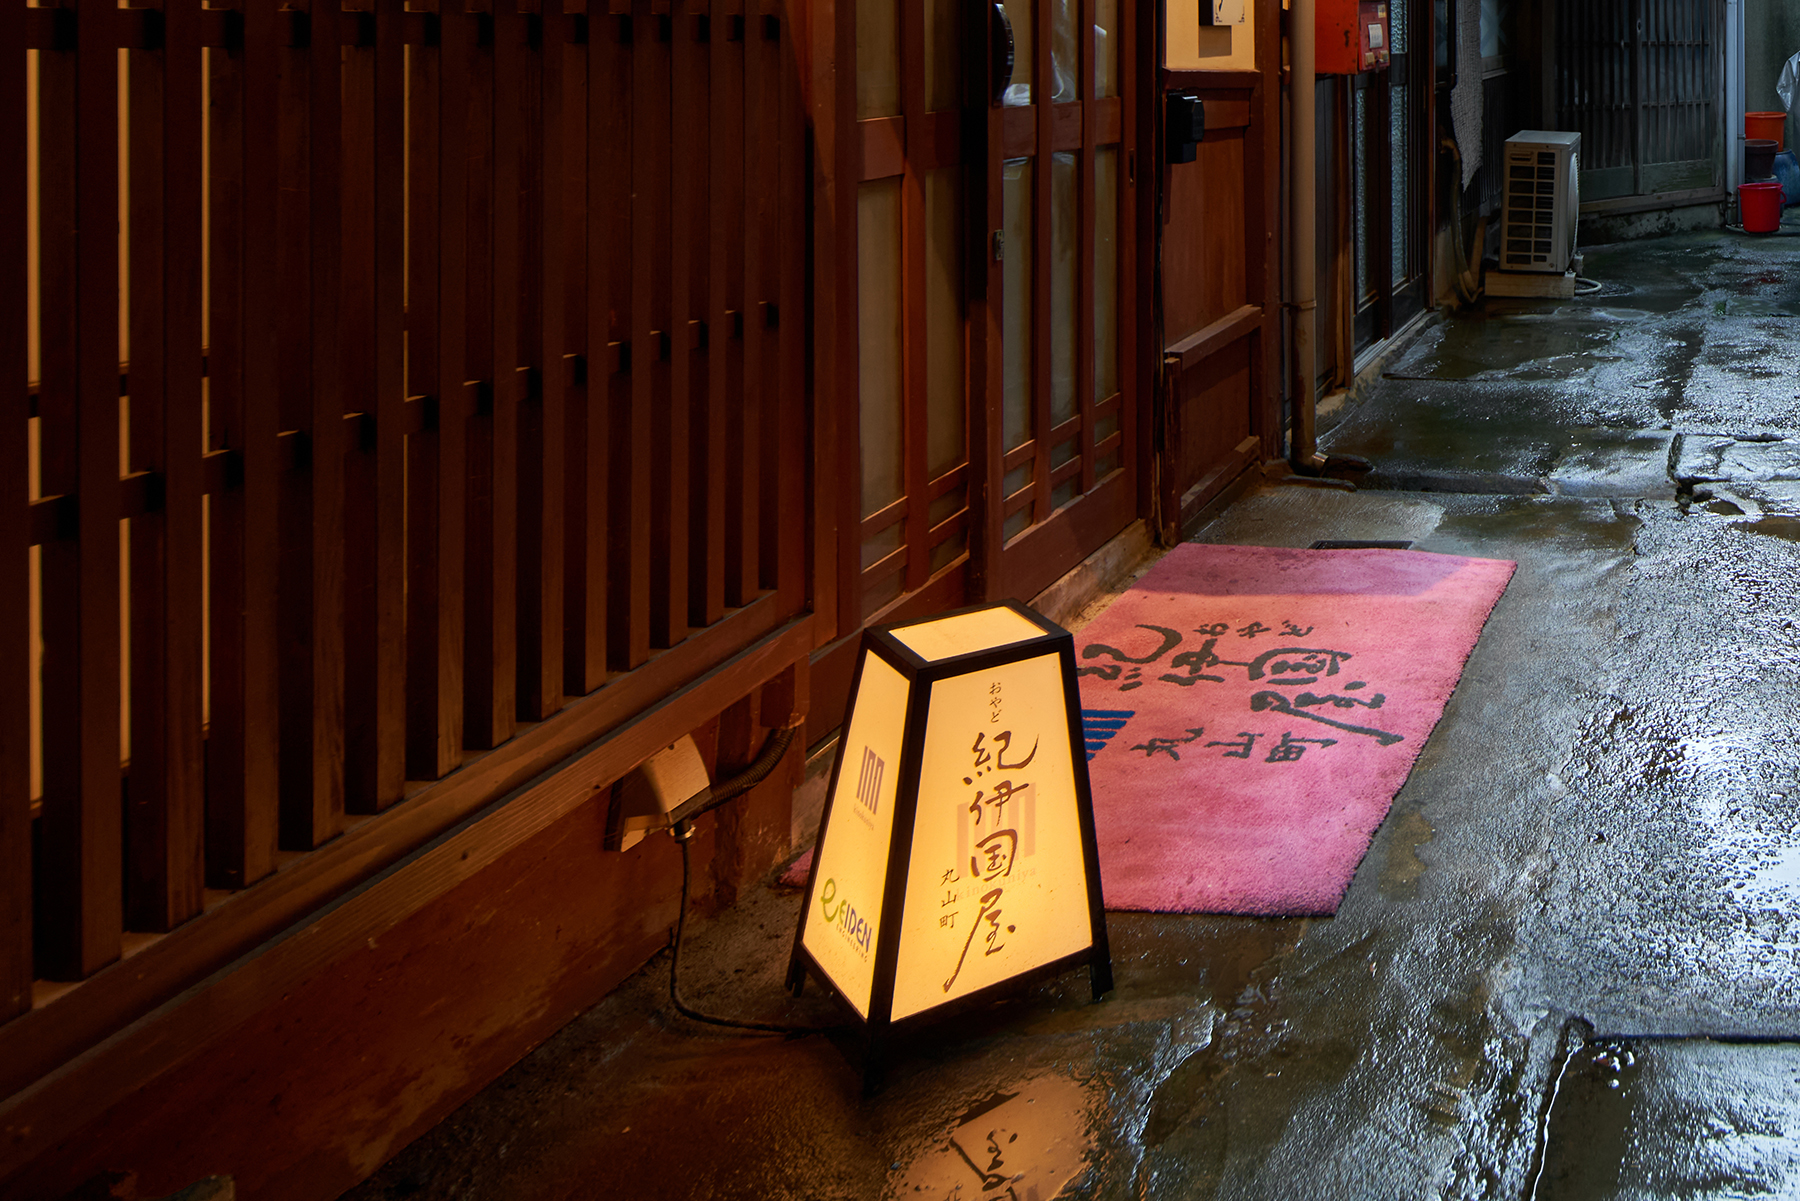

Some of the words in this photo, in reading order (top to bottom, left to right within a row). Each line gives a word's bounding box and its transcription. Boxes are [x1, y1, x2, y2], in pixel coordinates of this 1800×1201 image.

[989, 682, 1002, 723] おやど
[943, 730, 1040, 993] 紀伊国屋
[940, 868, 960, 929] 丸山町
